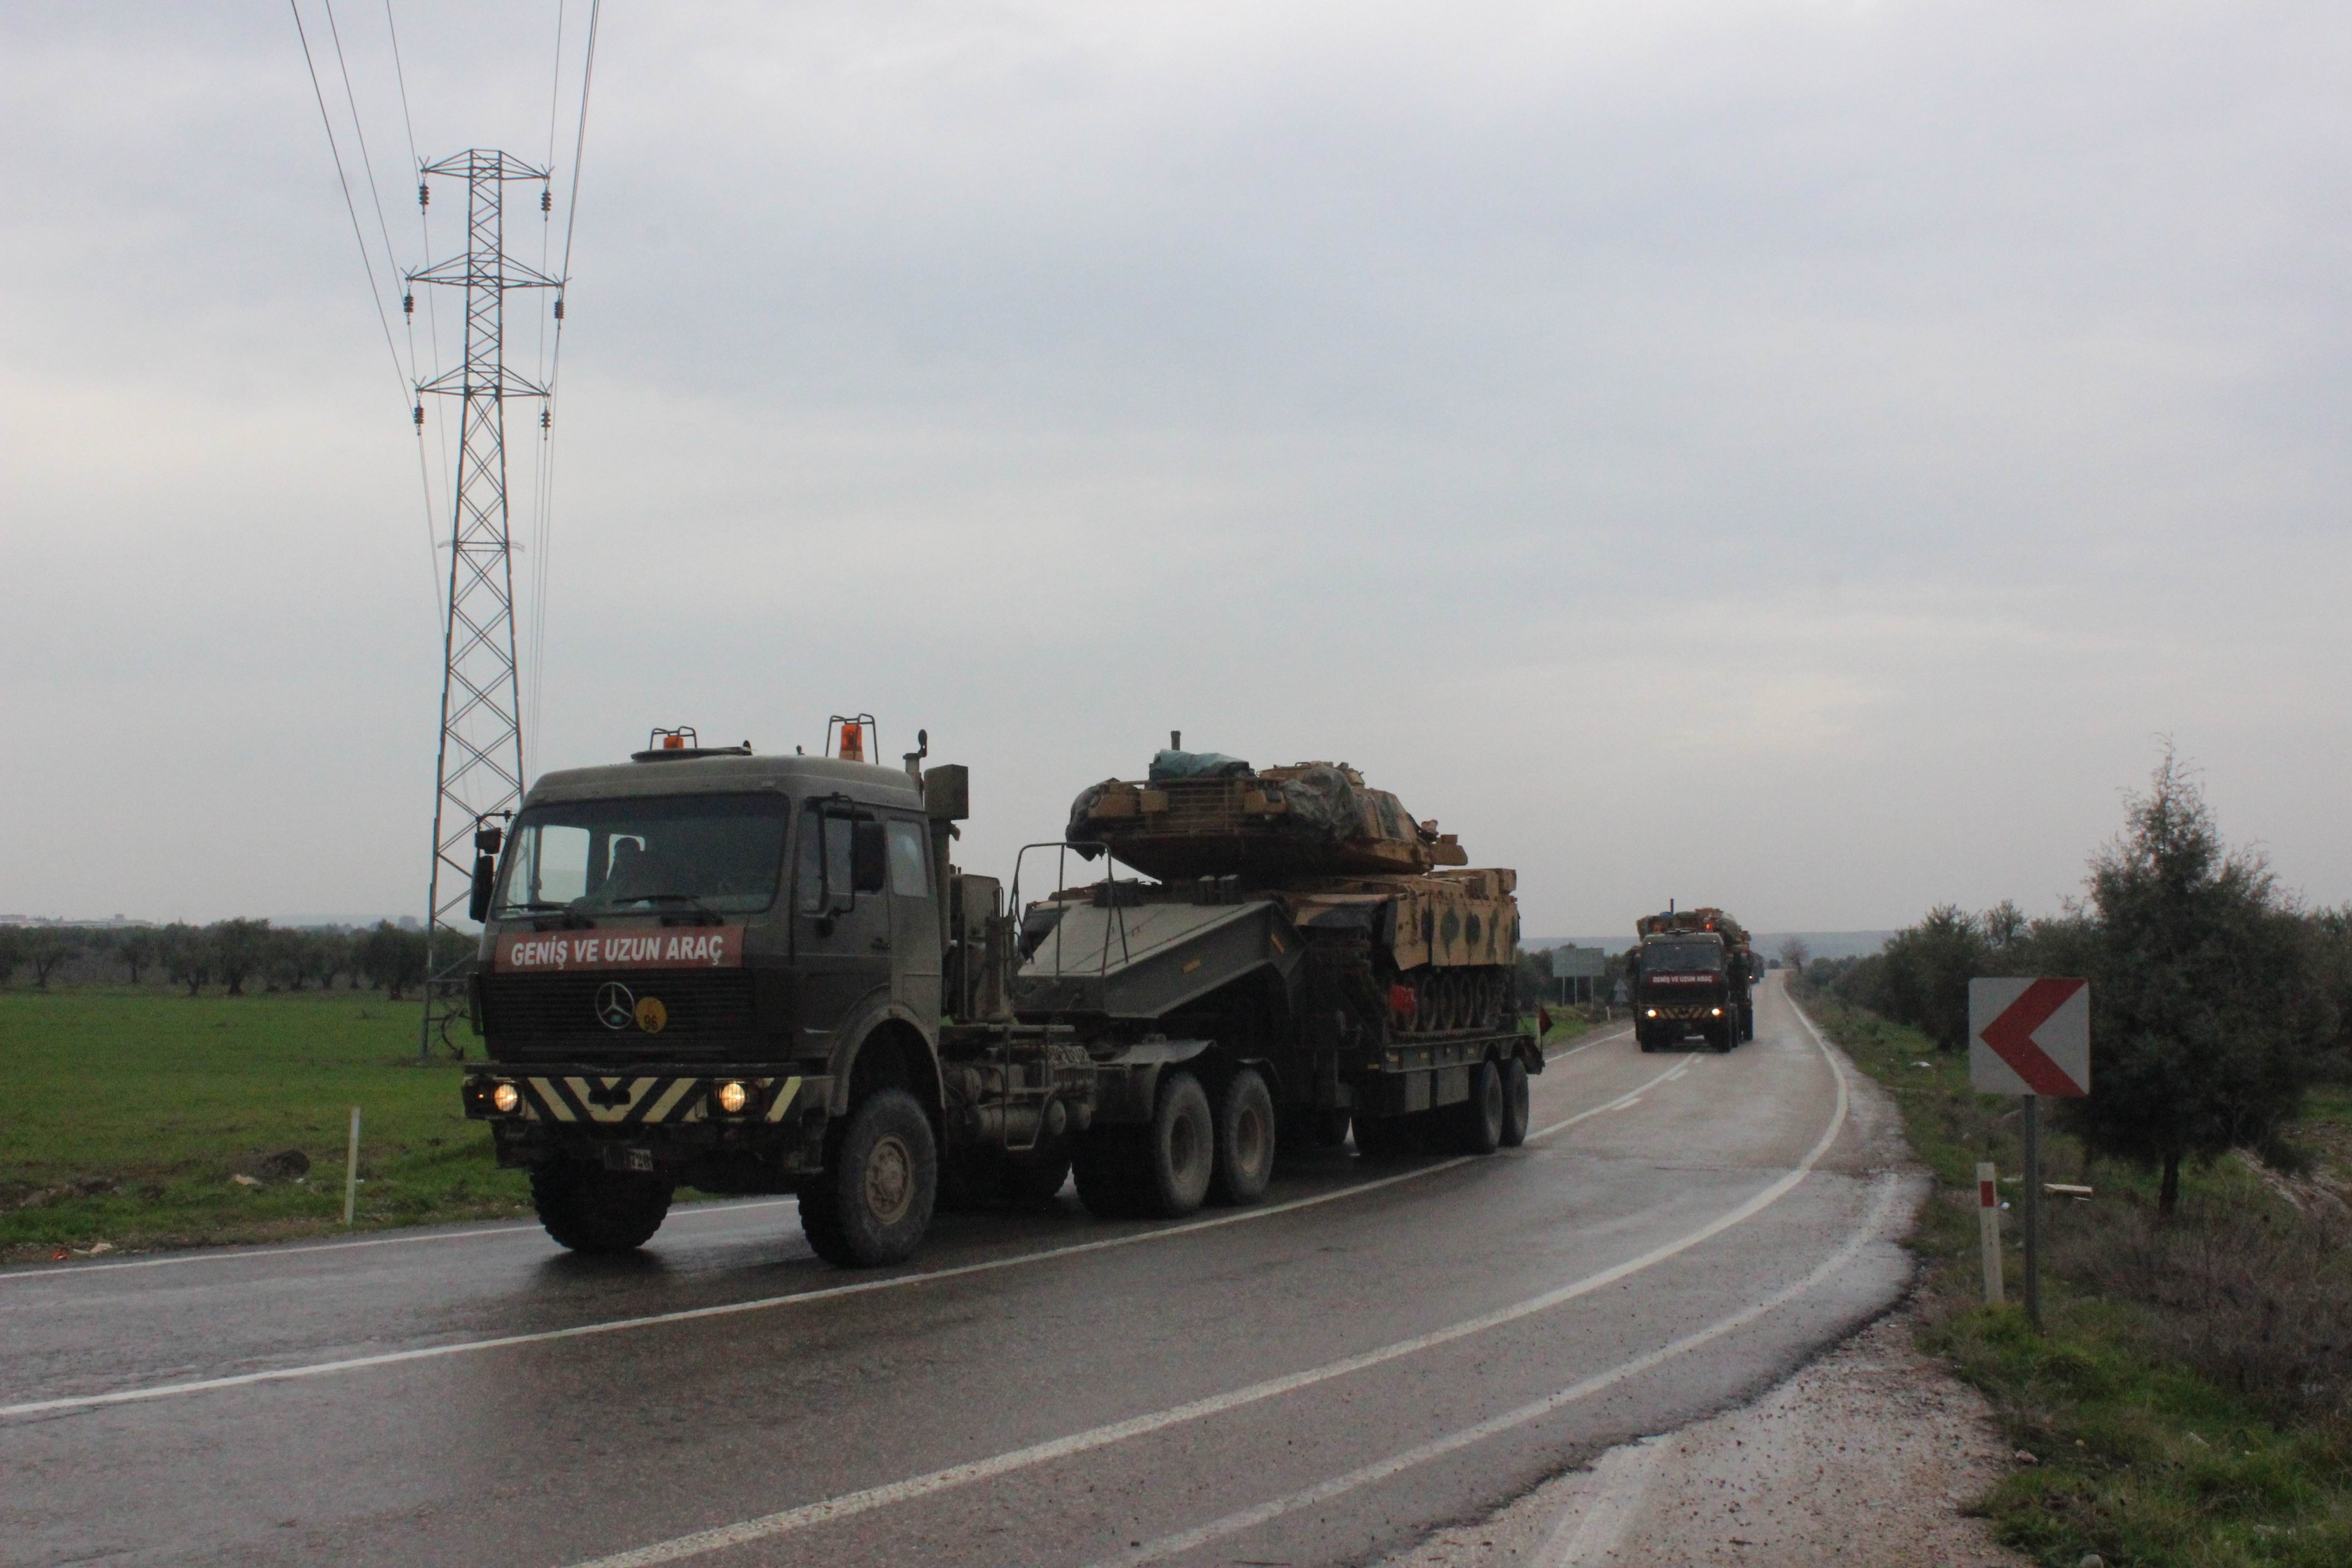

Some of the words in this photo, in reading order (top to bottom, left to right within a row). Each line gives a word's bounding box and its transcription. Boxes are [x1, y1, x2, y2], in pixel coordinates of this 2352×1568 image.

[512, 936, 567, 970] GENİŞ
[574, 939, 599, 962] VE
[605, 937, 661, 961] UZUN
[666, 936, 723, 965] ARAÇ
[644, 1014, 658, 1030] 96
